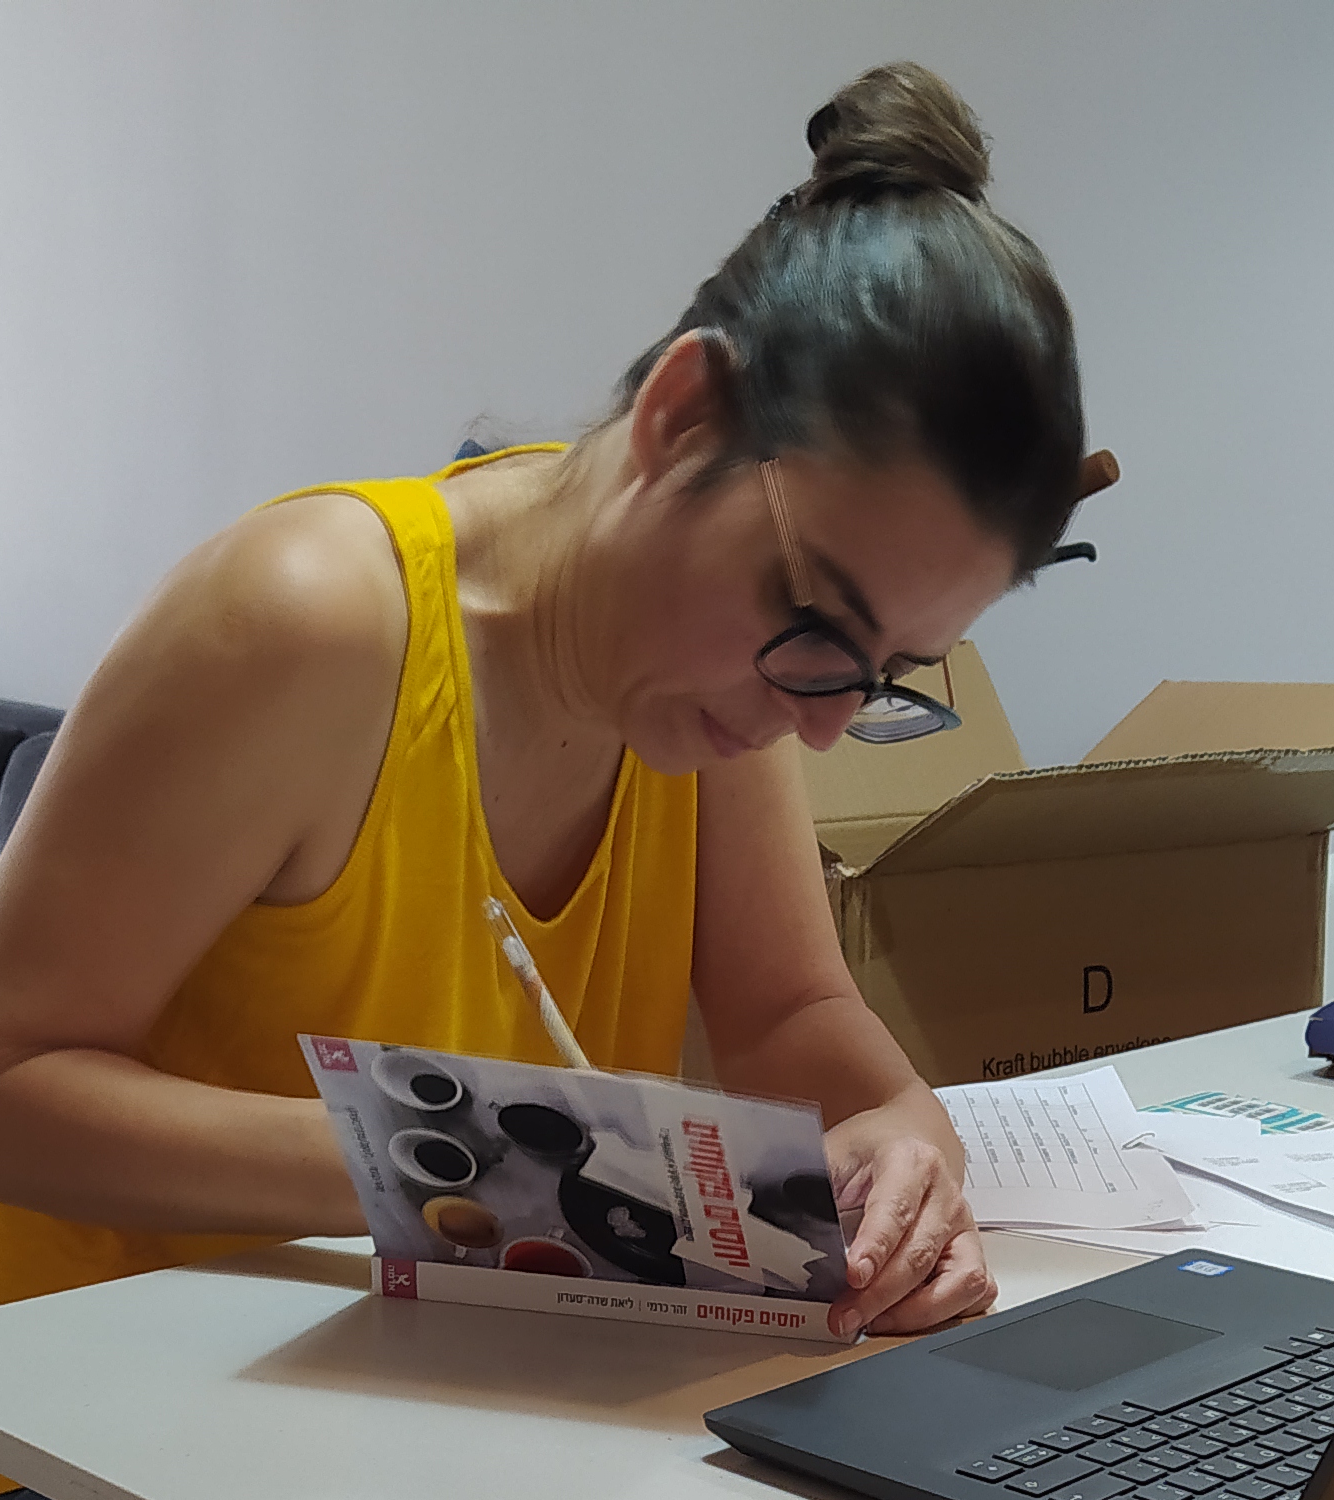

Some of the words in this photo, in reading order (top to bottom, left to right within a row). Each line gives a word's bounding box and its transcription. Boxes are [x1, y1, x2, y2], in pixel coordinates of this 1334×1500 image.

[1083, 965, 1113, 1014] D
[982, 1053, 1025, 1078] Kraft
[1029, 1045, 1089, 1071] bubble
[703, 1205, 749, 1267] יחסים
[610, 1296, 633, 1308] ליאת
[647, 1301, 668, 1312] כרמי
[670, 1304, 687, 1314] זהר
[696, 1304, 755, 1326] פקוחים
[760, 1309, 806, 1329] יחסים
